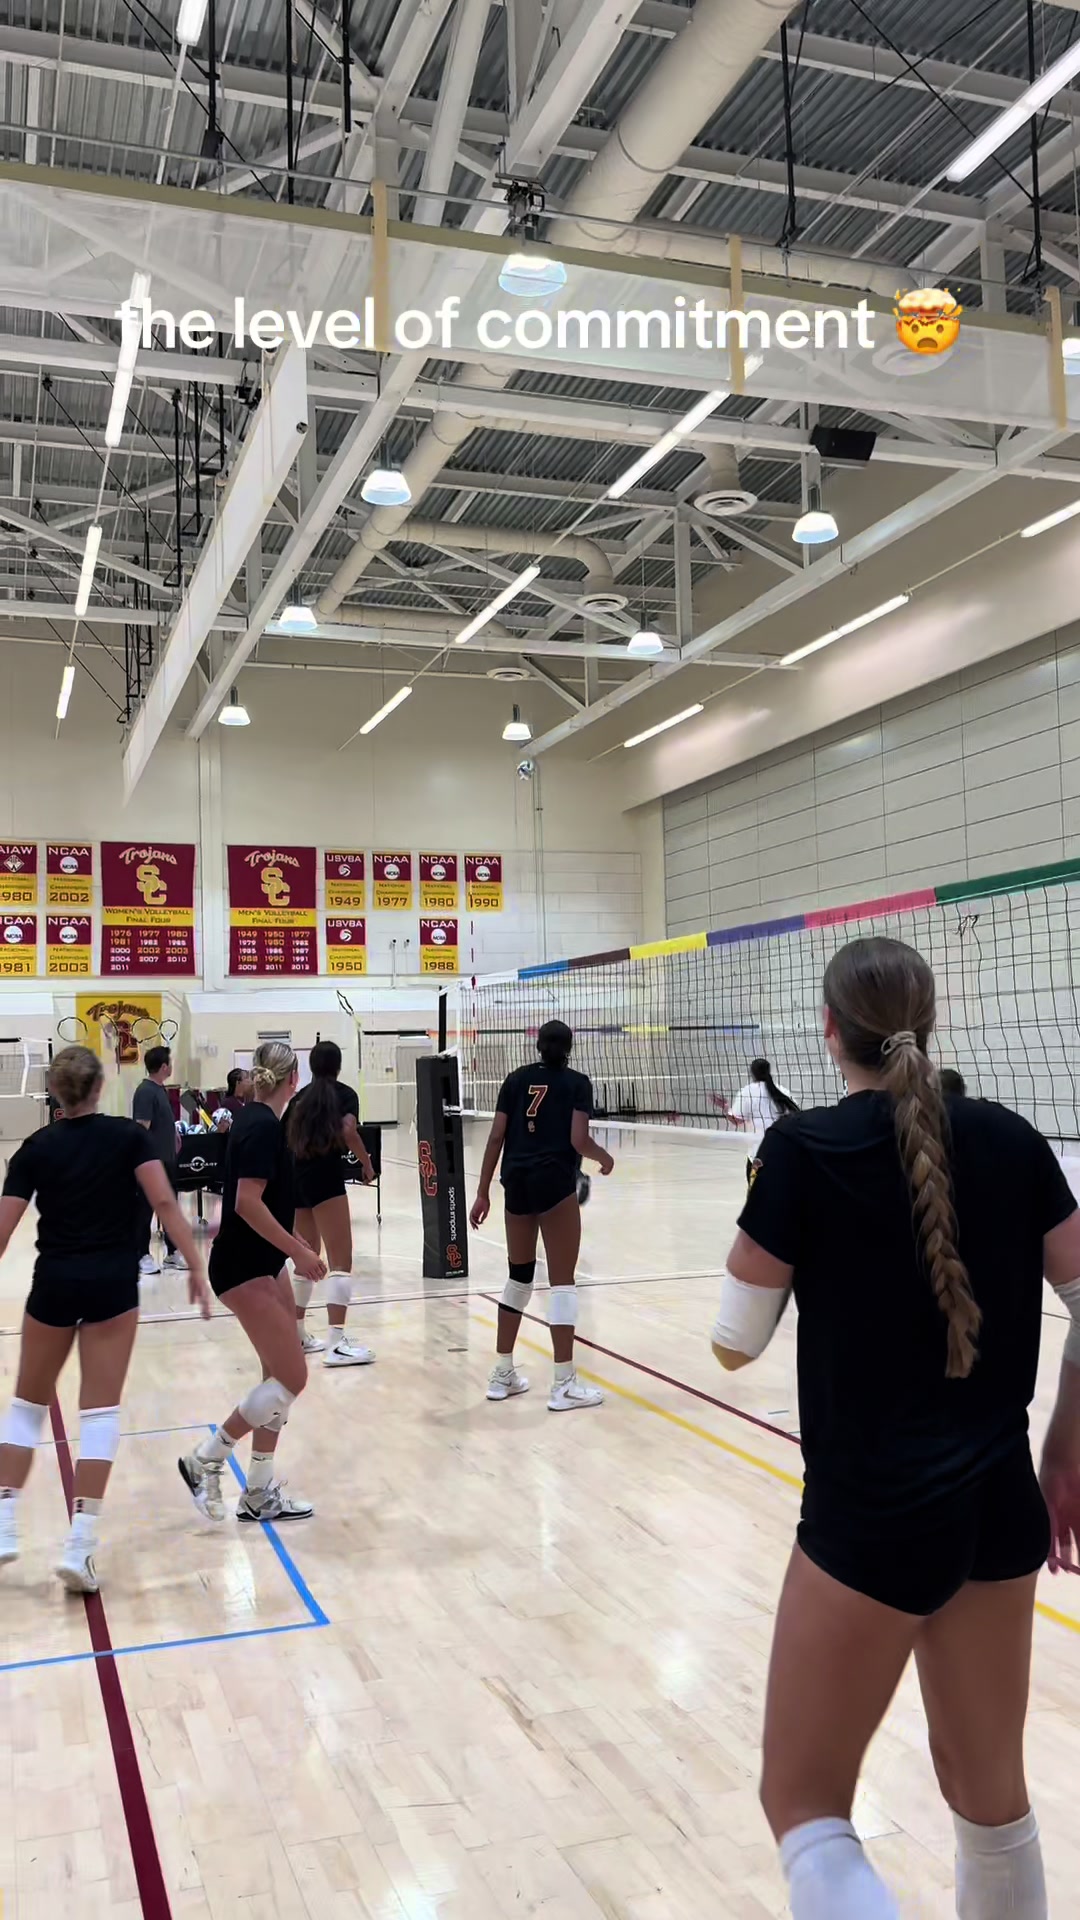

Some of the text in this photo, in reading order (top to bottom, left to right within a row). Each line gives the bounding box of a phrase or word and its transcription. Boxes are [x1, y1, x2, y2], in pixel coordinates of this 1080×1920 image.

[48, 847, 89, 856] NCAA
[119, 847, 177, 865] Trojans
[244, 849, 300, 868] Trojans
[326, 854, 361, 862] USVBA
[374, 855, 409, 863] NCAA
[421, 856, 455, 864] NCAA
[466, 857, 499, 865] NCAA
[0, 891, 32, 902] 980
[49, 892, 90, 902] 2002
[329, 896, 361, 906] 1949
[378, 897, 408, 906] 1977
[424, 897, 454, 907] 1980
[48, 917, 90, 925] NCAA
[328, 920, 363, 928] USVBA
[421, 920, 456, 928] NCAA
[49, 962, 89, 972] 2003
[330, 961, 362, 971] 1950
[424, 961, 454, 971] 1988
[526, 1085, 548, 1117] 7
[448, 1186, 457, 1241] sports imports
